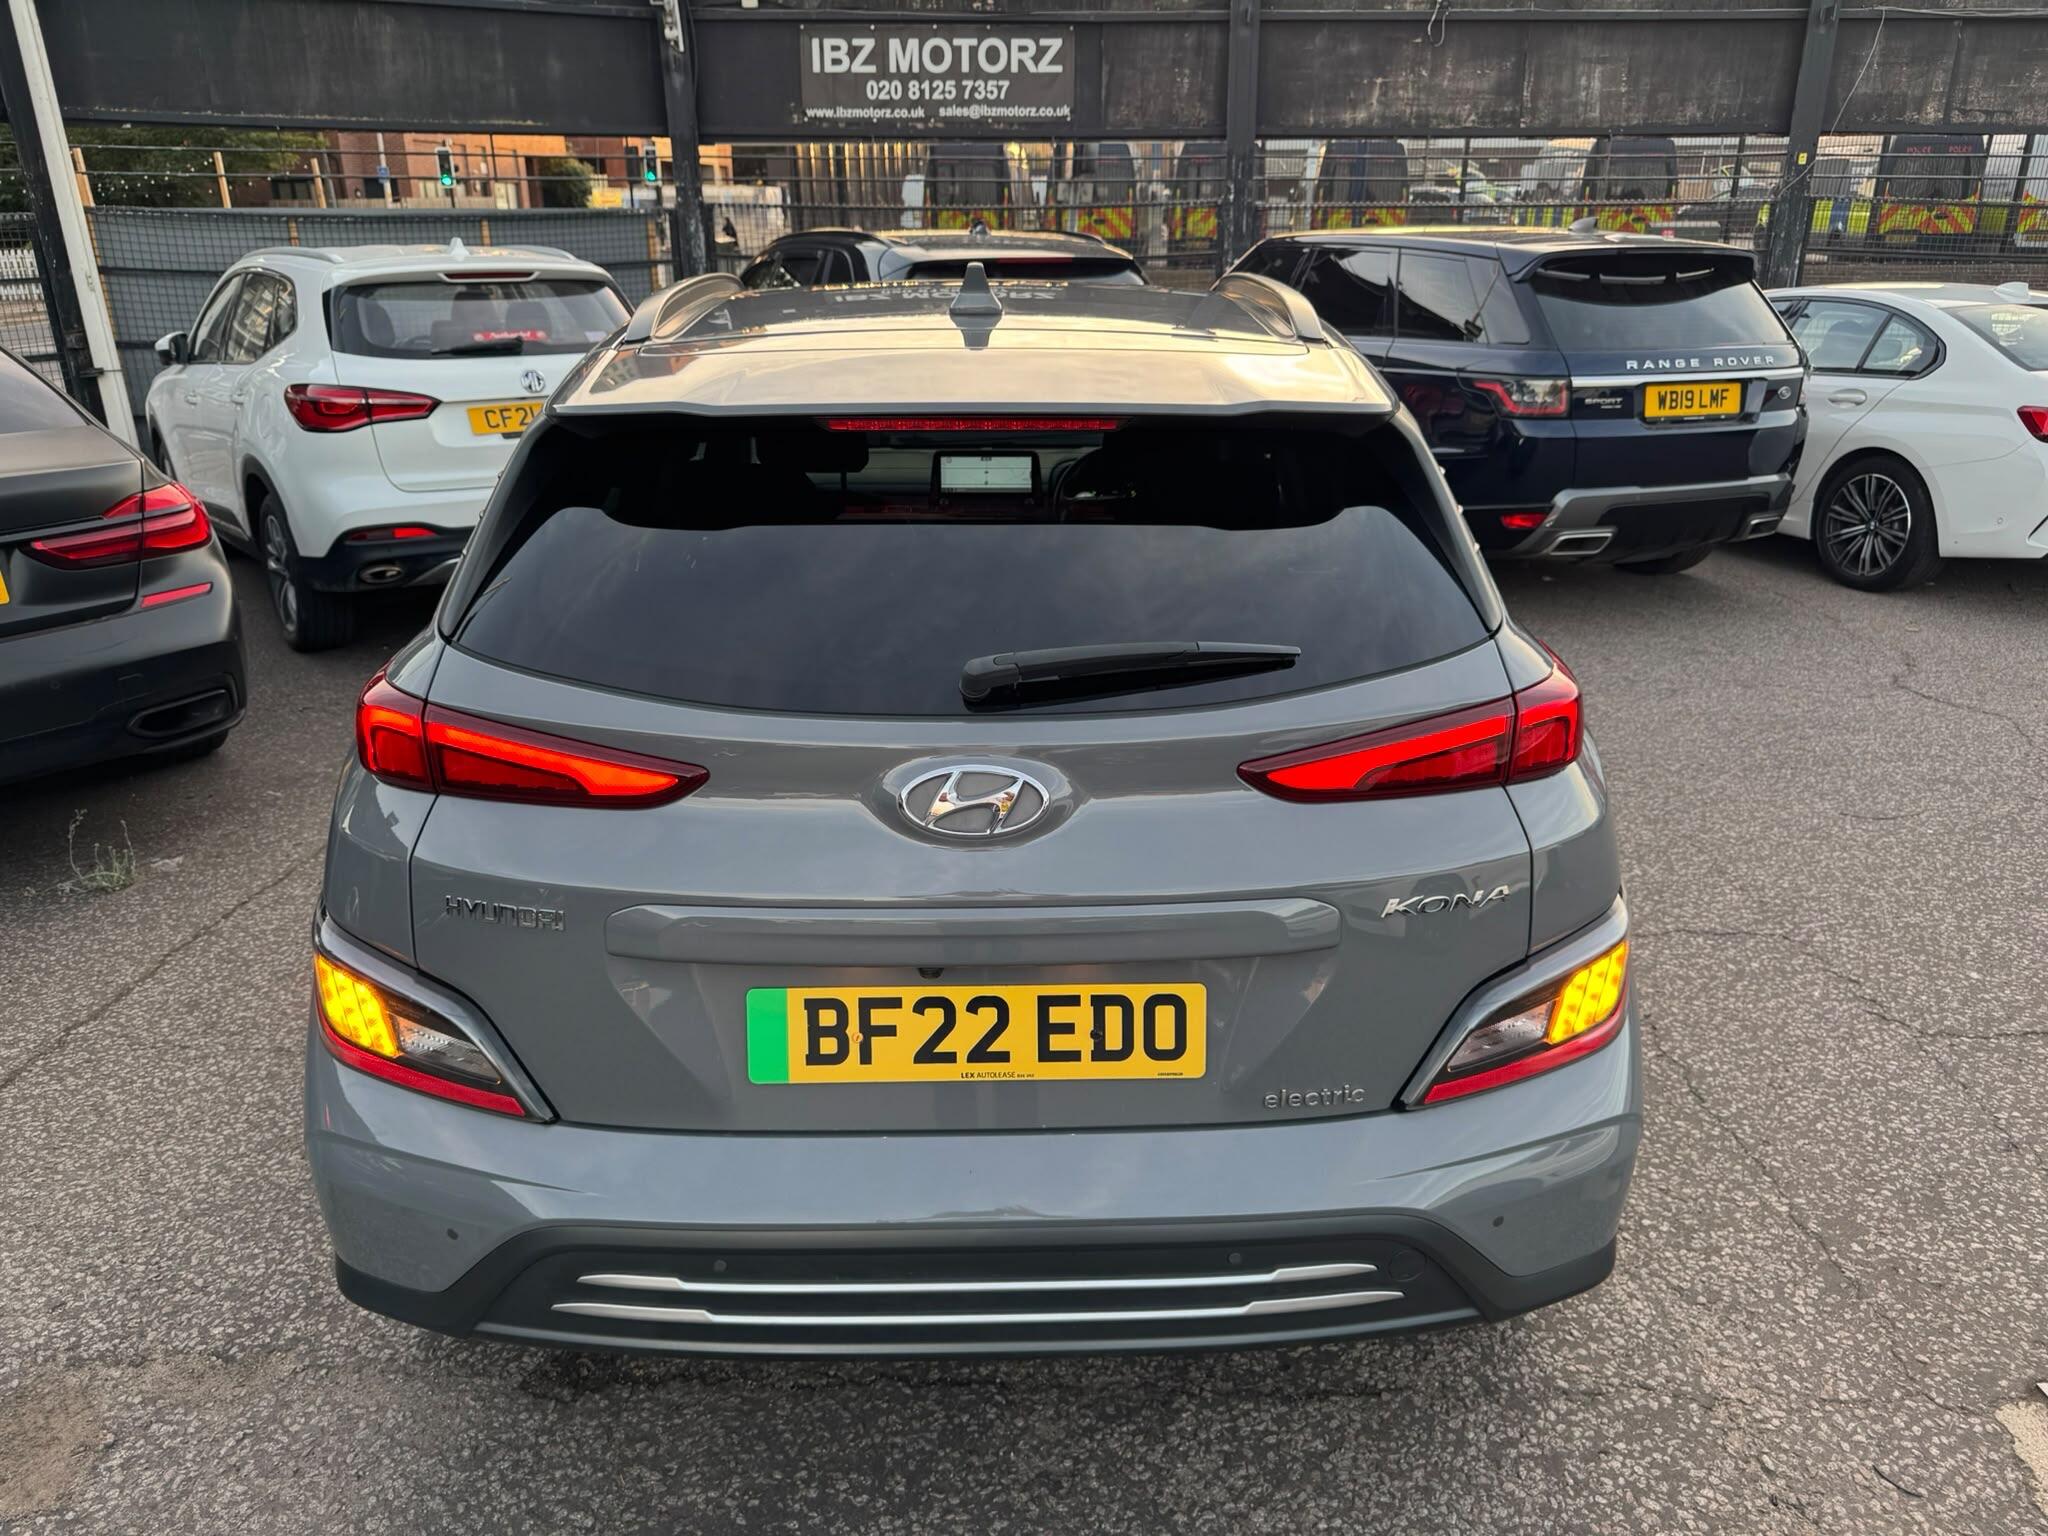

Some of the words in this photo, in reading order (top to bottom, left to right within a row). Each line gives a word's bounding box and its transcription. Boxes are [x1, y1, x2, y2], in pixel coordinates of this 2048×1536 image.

[811, 37, 877, 73] IBZ
[888, 37, 1064, 73] MOTORZ
[866, 80, 902, 100] 020
[908, 80, 956, 100] 8125
[962, 80, 1010, 100] 7357
[805, 105, 925, 119] www.ibzmotorz.co.uk
[938, 104, 1071, 119] sales@ibzmotorz.co.uk
[1626, 358, 1701, 370] RANGE
[1713, 355, 1775, 367] ROVER
[521, 370, 545, 393] MG
[1657, 390, 1694, 411] WB19
[1699, 388, 1730, 409] LMF
[445, 895, 565, 931] HYUNDAI
[1381, 885, 1510, 918] KONA
[804, 995, 1011, 1066] BF22
[1037, 993, 1187, 1063] EDO
[1264, 1084, 1365, 1108] electric
